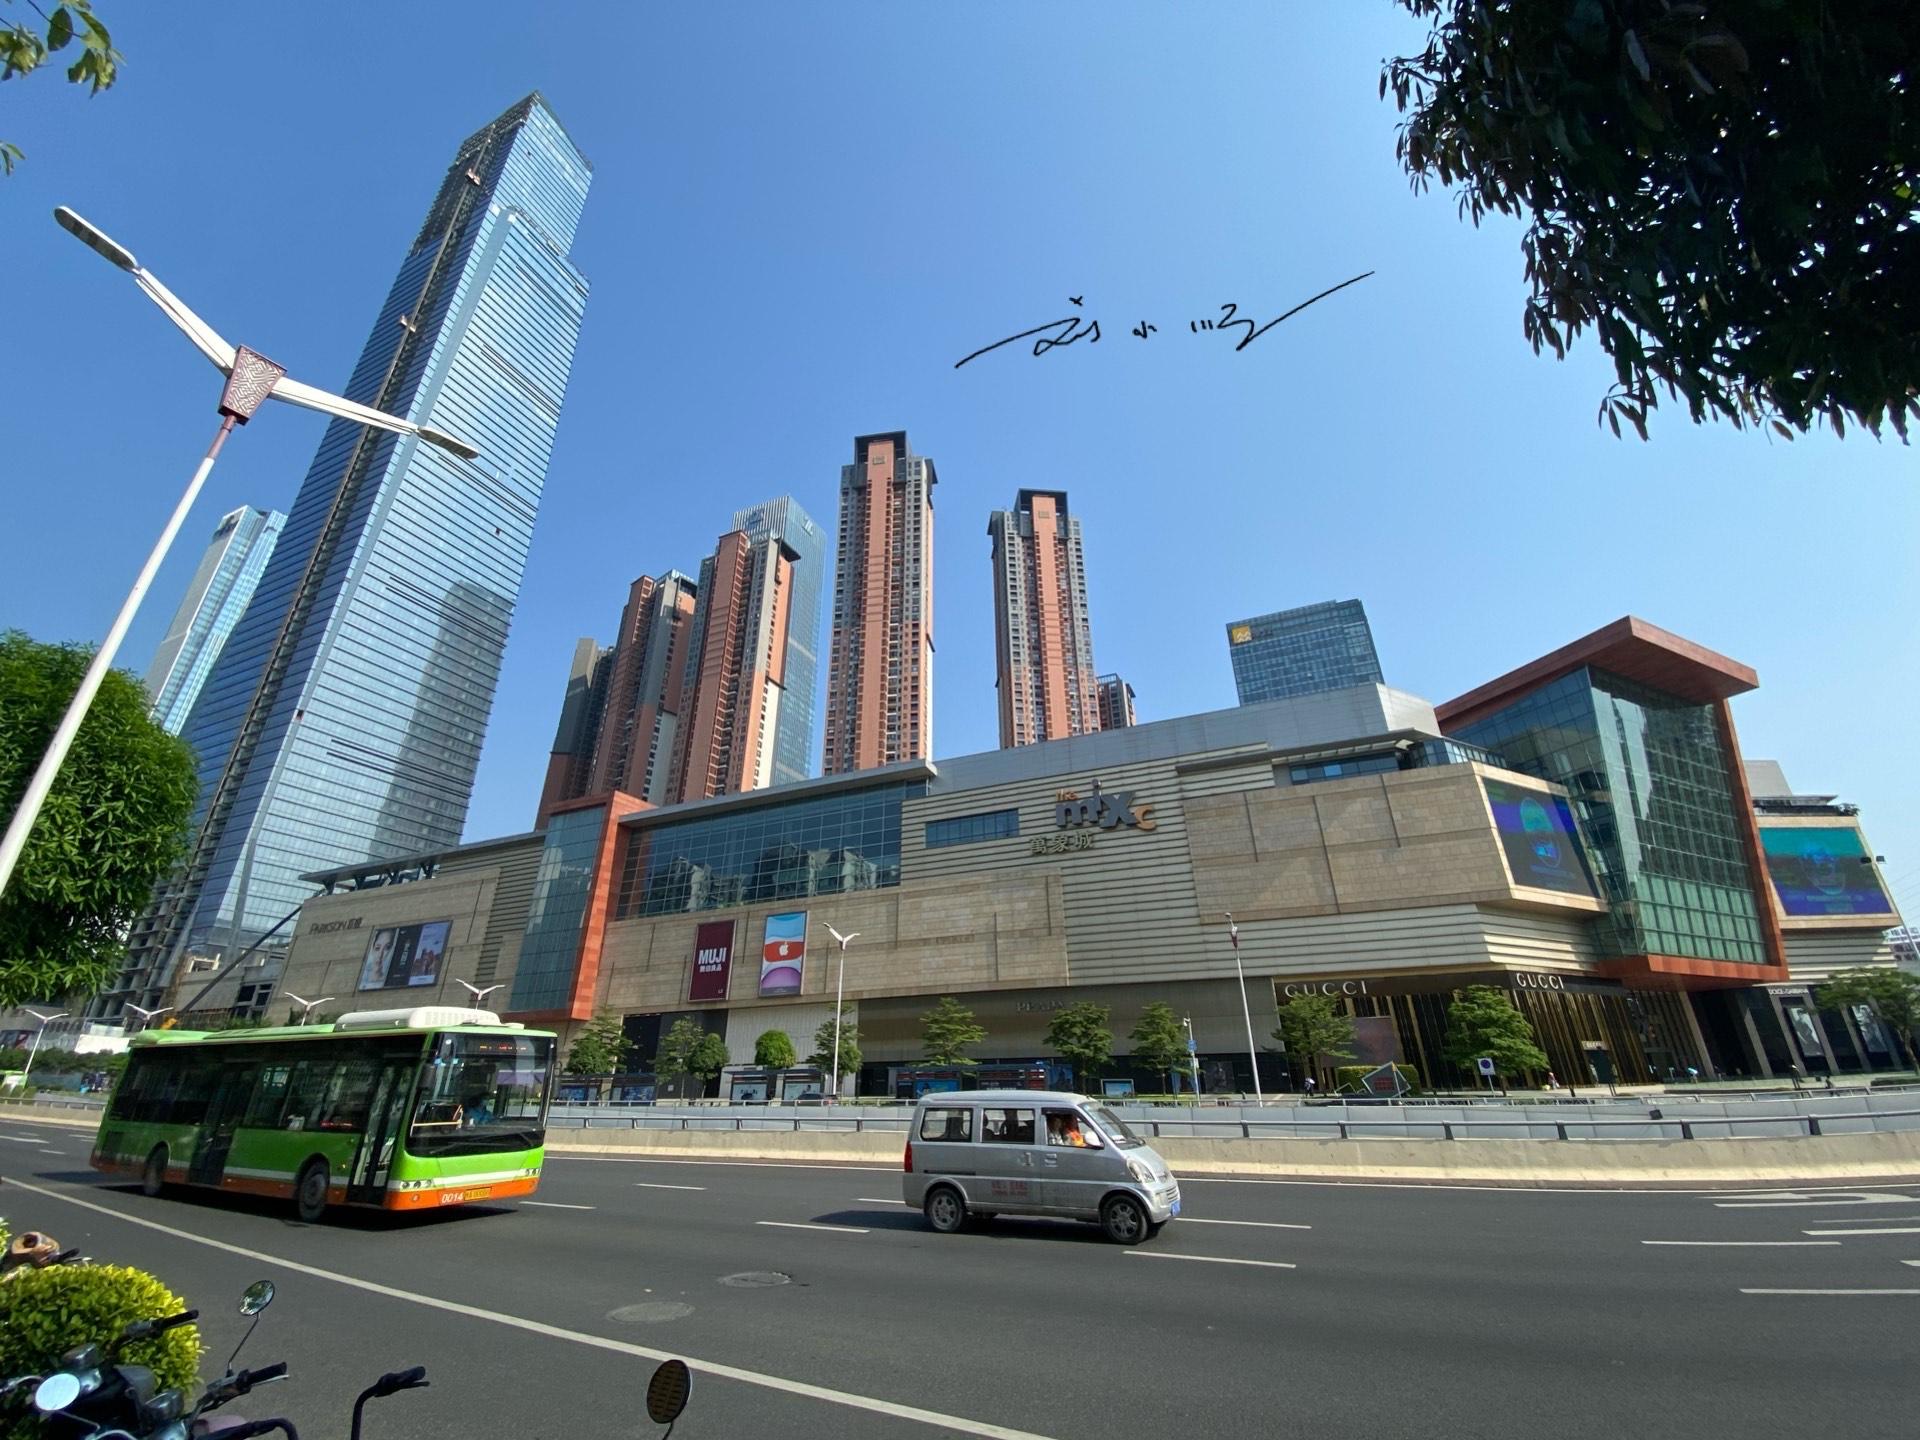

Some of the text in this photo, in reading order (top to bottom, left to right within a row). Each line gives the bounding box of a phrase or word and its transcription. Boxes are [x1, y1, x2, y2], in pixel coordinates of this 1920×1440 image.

[1028, 830, 1095, 855] 萬象城
[698, 946, 727, 965] MUJI
[1284, 980, 1368, 998] GUCCI
[1516, 972, 1565, 990] GUCCI
[441, 1191, 464, 1204] 0014
